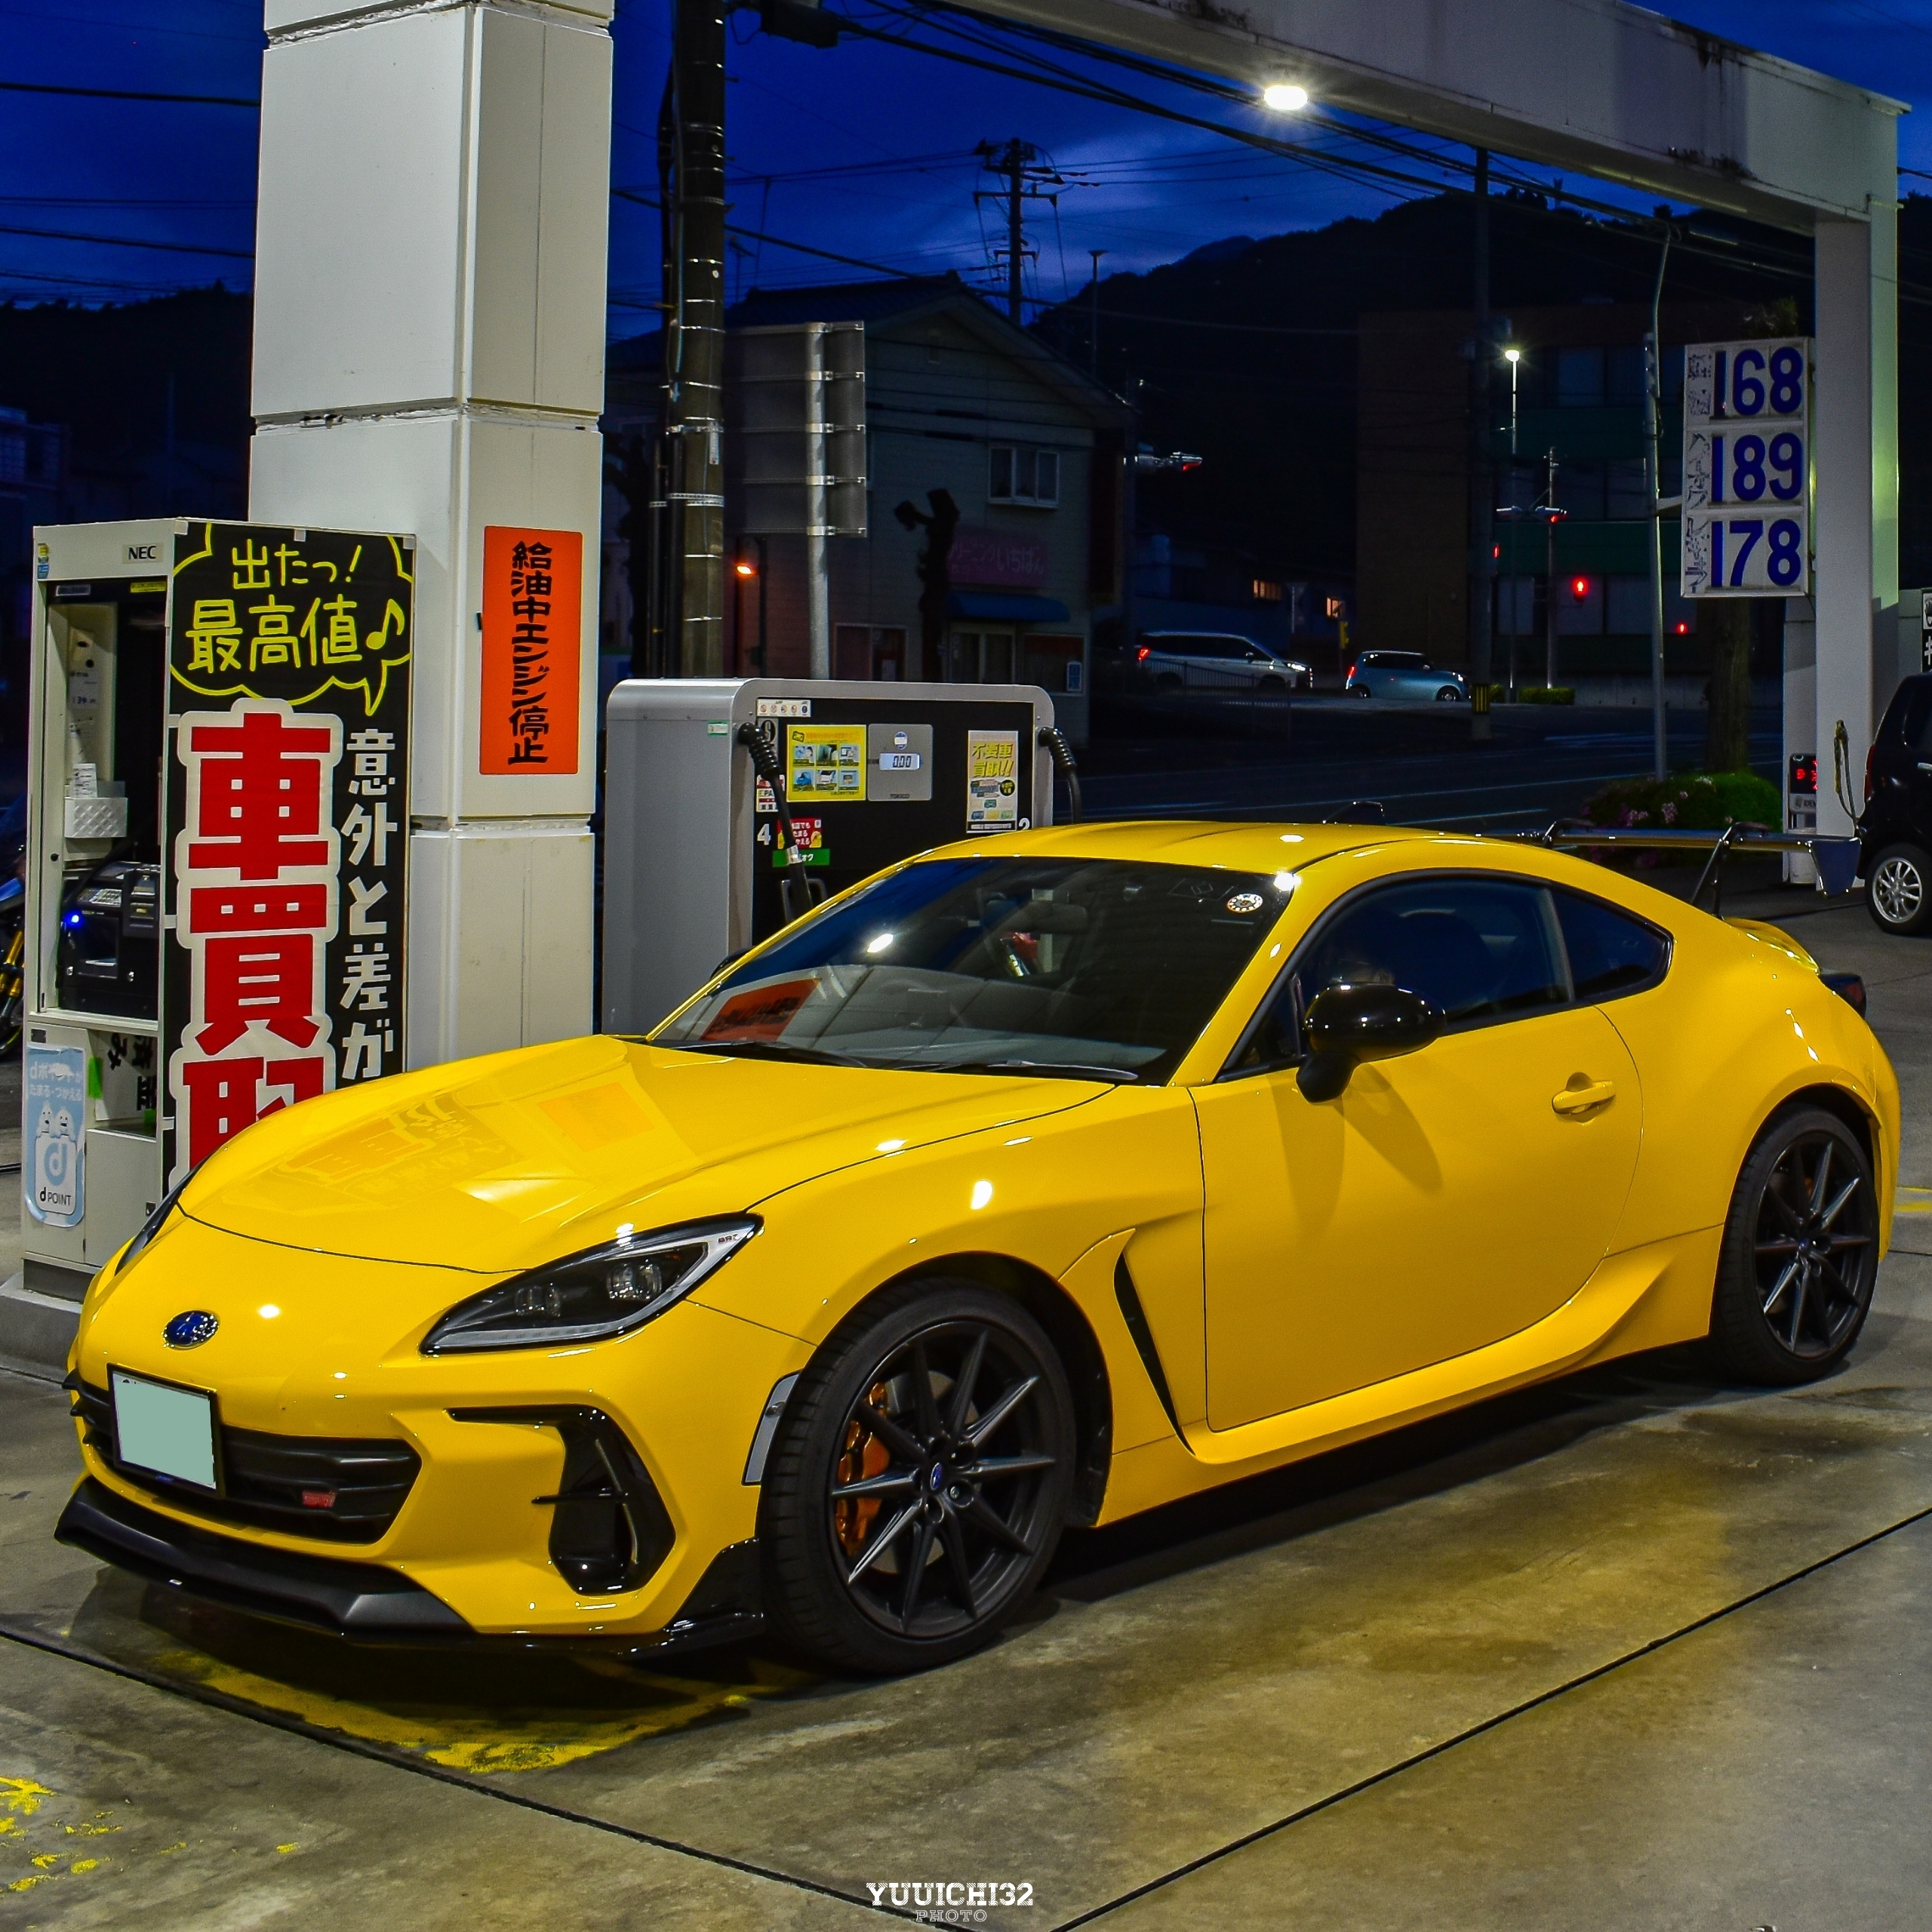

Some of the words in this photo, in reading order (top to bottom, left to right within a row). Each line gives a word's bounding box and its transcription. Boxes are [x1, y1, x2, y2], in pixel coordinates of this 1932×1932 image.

[1714, 346, 1804, 416] 168
[1711, 432, 1803, 503] 189
[128, 546, 157, 560] NEC
[1711, 518, 1801, 587] 178
[507, 540, 553, 765] 給油中エンジン停止
[972, 743, 1014, 759] 不要車
[757, 823, 771, 845] 4
[340, 728, 398, 1081] 意外と差が
[47, 1191, 72, 1207] POINT
